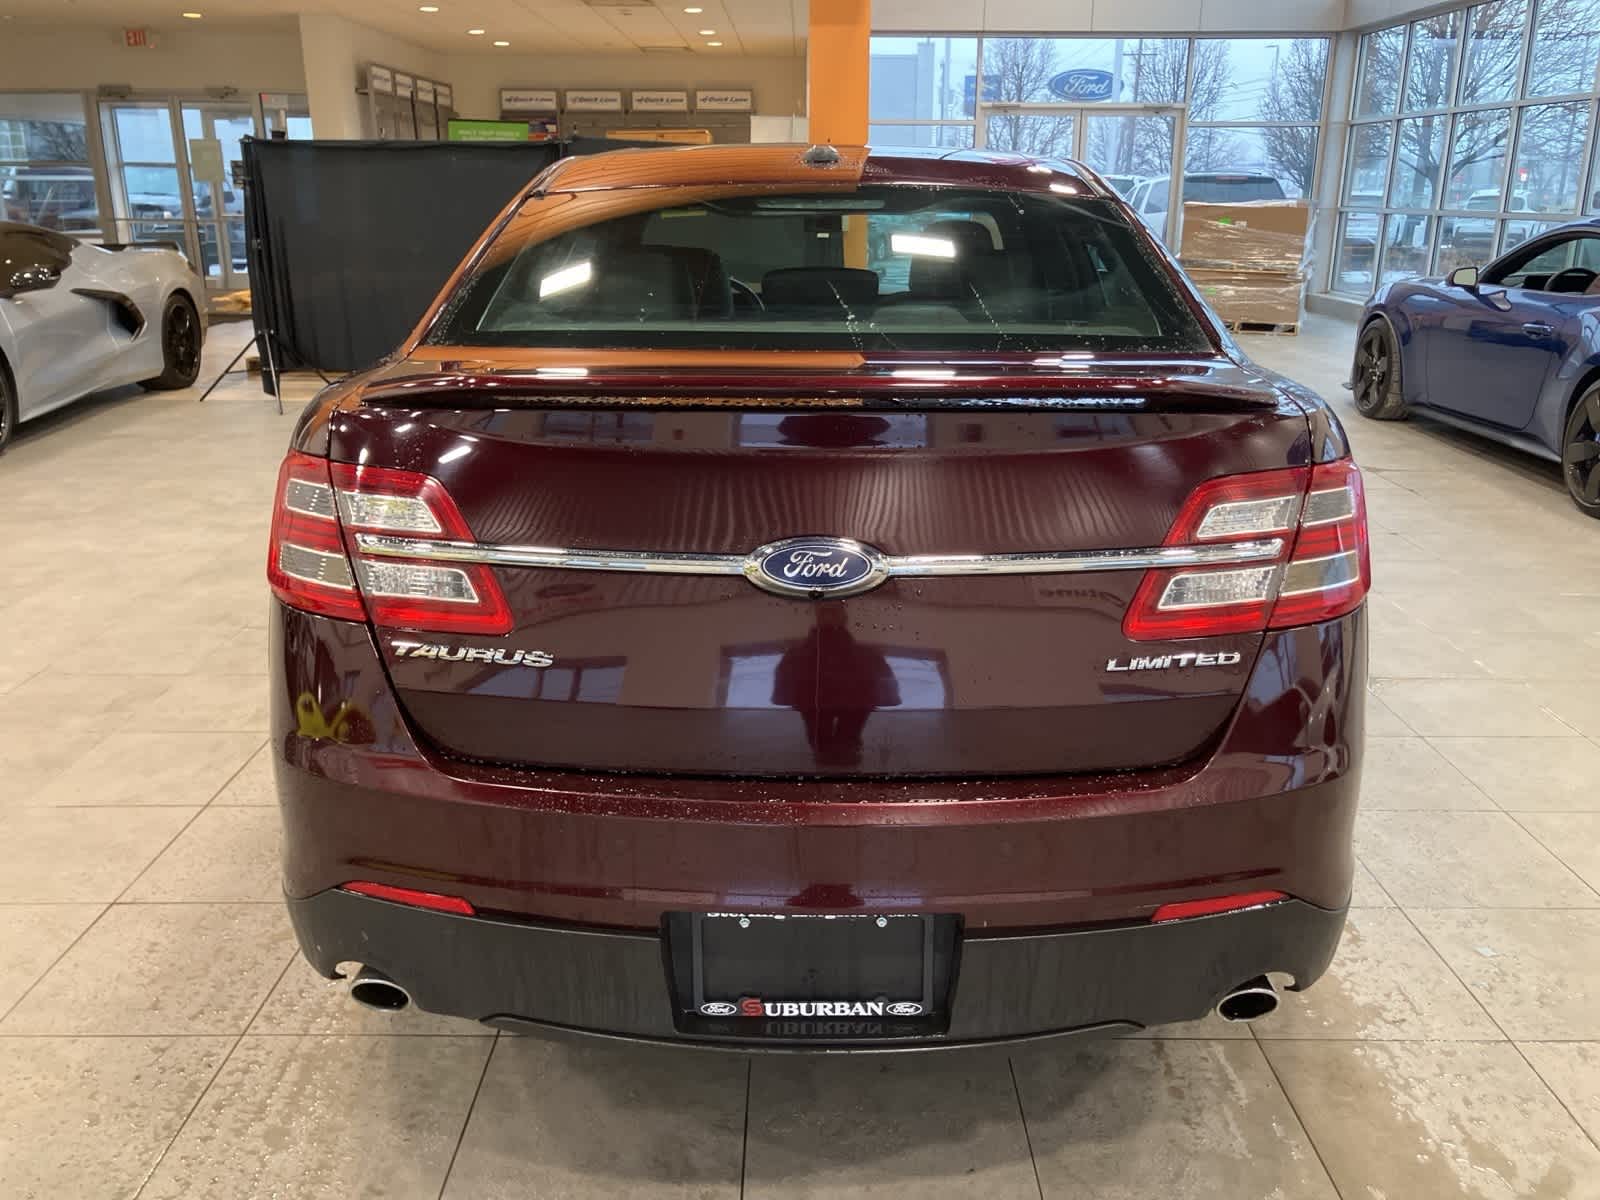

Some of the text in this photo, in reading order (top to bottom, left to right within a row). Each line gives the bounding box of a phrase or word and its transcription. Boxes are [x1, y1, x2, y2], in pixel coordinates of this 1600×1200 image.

[1064, 74, 1110, 95] Ford
[783, 550, 849, 578] Ford
[391, 640, 554, 668] TAURUS
[1106, 651, 1241, 672] LIMITED
[741, 999, 884, 1017] SUBURBAN
